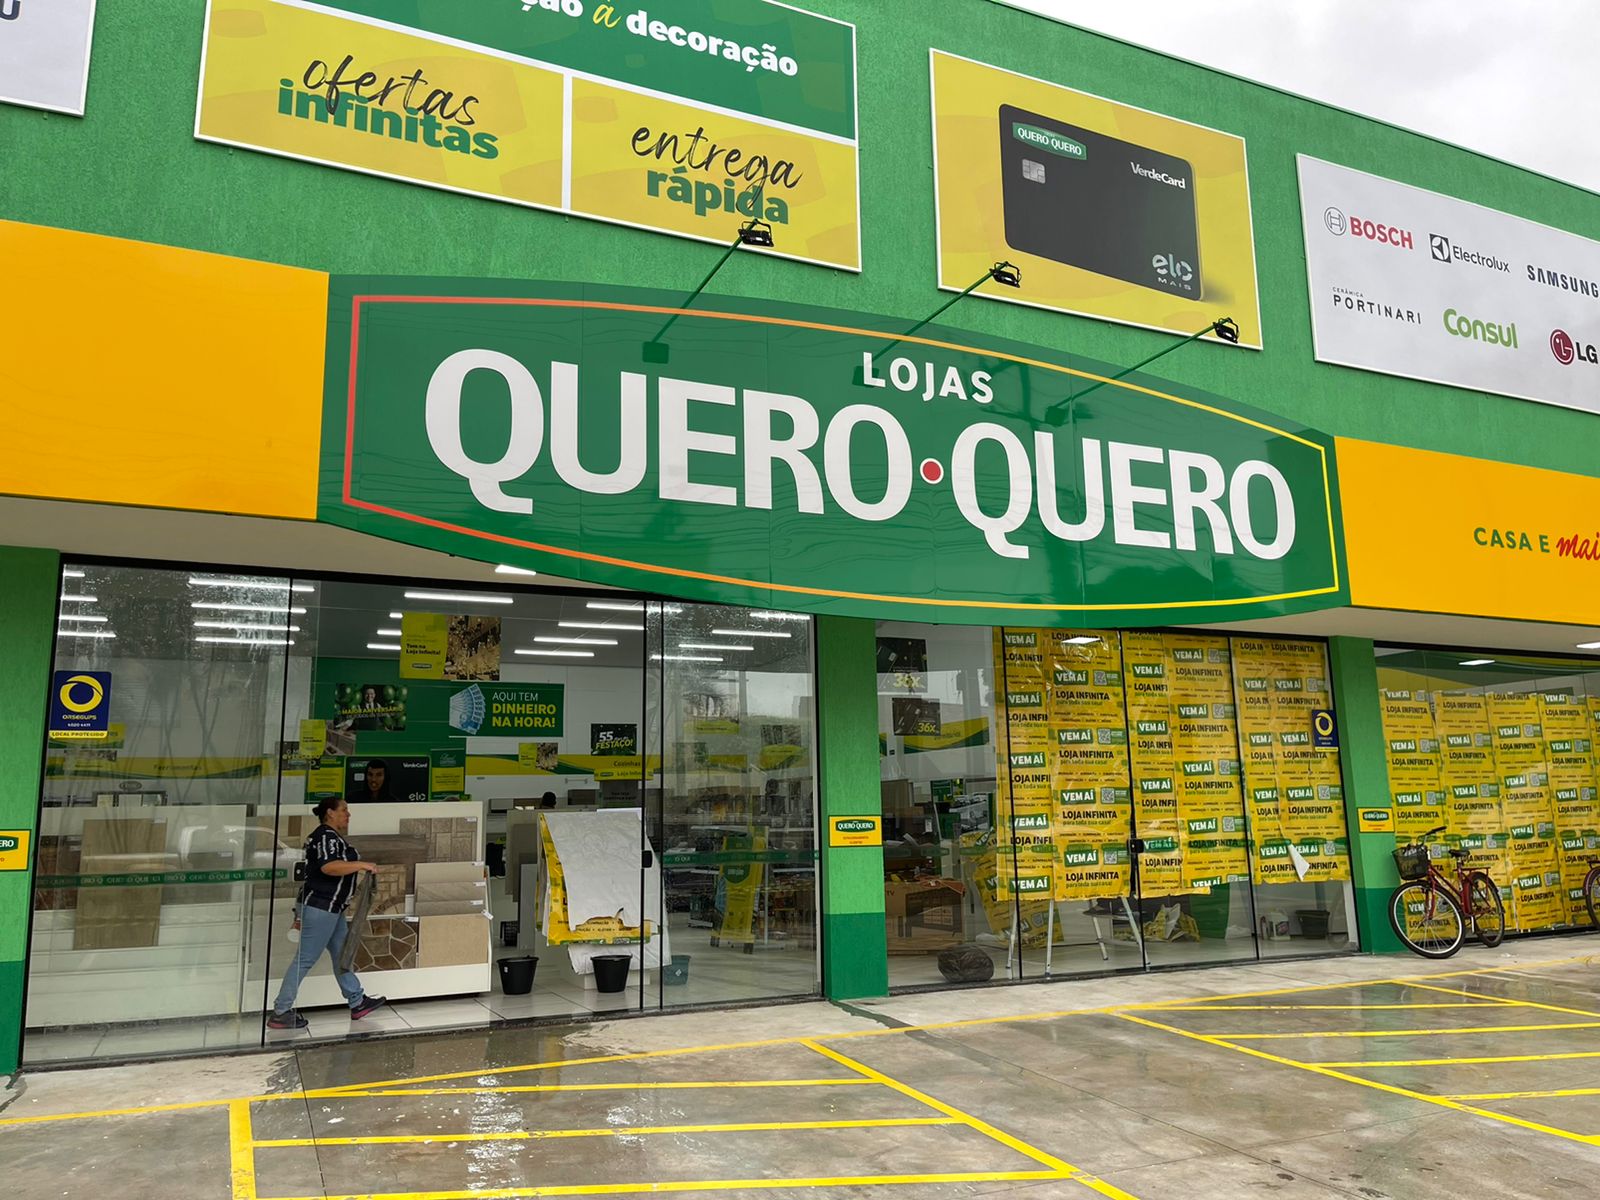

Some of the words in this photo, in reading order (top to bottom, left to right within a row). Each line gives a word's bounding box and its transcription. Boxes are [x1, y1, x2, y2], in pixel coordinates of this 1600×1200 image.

[626, 10, 798, 76] decoração
[303, 55, 479, 126] ofertas
[278, 78, 499, 160] infinitas
[1017, 127, 1049, 145] QUERO
[1051, 140, 1082, 156] QUERO
[631, 127, 803, 212] entrega
[1130, 161, 1186, 189] VerdeCard
[647, 167, 789, 225] rápida
[1350, 216, 1413, 250] BOSCH
[1453, 246, 1511, 273] Electrolux
[1152, 253, 1193, 281] elo
[1158, 276, 1192, 290] MAIS
[1526, 264, 1599, 298] SAMSUNG
[1332, 287, 1364, 298] CERÂMICA
[1333, 294, 1421, 325] PORTINARI
[1443, 308, 1518, 349] Consul
[1576, 342, 1599, 365] LG
[862, 351, 994, 406] LOJAS
[425, 348, 913, 521] QUERO
[951, 421, 1297, 561] QUERO
[1473, 527, 1533, 551] CASA
[1539, 534, 1550, 553] E
[1005, 635, 1022, 644] VEM
[1175, 651, 1192, 659] VEM
[1194, 650, 1202, 659] AÍ
[1134, 666, 1152, 675] VEM
[1154, 664, 1163, 674] AÍ
[1176, 667, 1191, 676] LOJA
[1193, 668, 1223, 676] INFINITA
[1056, 672, 1075, 681] VEM
[1077, 671, 1086, 681] AÍ
[1134, 683, 1151, 692] LOJA
[492, 691, 516, 702] AQUI
[518, 692, 538, 701] TEM
[1008, 695, 1029, 703] VEM
[1056, 691, 1075, 700] LOJA
[1076, 691, 1110, 700] INFINITA
[492, 703, 556, 714] DINHEIRO
[1180, 707, 1197, 715] VEM
[1199, 704, 1207, 714] AÍ
[1402, 706, 1428, 714] INFINITA
[492, 716, 511, 727] NA
[514, 717, 556, 728] HORA!
[917, 722, 936, 733] 36x
[1138, 723, 1156, 732] VEM
[1157, 721, 1166, 731] AÍ
[1180, 724, 1196, 732] LOJA
[1197, 724, 1229, 732] INFINITA
[599, 731, 614, 742] 55
[1060, 732, 1079, 741] VEM
[1081, 729, 1091, 740] AÍ
[1250, 735, 1267, 743] VEM
[1300, 732, 1308, 742] AÍ
[595, 738, 633, 750] FESTAÇO!
[1138, 740, 1154, 749] LOJA
[1391, 742, 1406, 750] VEM
[1407, 740, 1415, 750] AÍ
[1010, 756, 1032, 765] VEM
[1033, 751, 1043, 764] AÍ
[1059, 750, 1078, 759] LOJA
[1080, 750, 1114, 758] INFINITA
[1251, 752, 1266, 760] LOJA
[1184, 764, 1202, 772] VEM
[1204, 761, 1212, 771] AÍ
[1392, 758, 1406, 766] LOJA
[1407, 758, 1434, 766] INFINITA
[1142, 781, 1160, 790] VEM
[1161, 778, 1171, 789] AÍ
[1185, 781, 1202, 790] LOJA
[1203, 781, 1234, 789] INFINITA
[1063, 792, 1082, 801] VEM
[1084, 790, 1094, 800] AÍ
[1255, 791, 1272, 799] VEM
[1288, 789, 1304, 798] VEM
[1454, 787, 1469, 795] VEM
[1469, 785, 1477, 794] AÍ
[408, 792, 426, 801] elo
[1397, 795, 1412, 803] VEM
[1413, 793, 1421, 802] AÍ
[1142, 800, 1158, 808] LOJA
[1454, 803, 1468, 811] LOJA
[1063, 811, 1082, 820] LOJA
[1083, 811, 1117, 819] INFINITA
[1256, 808, 1273, 816] LOJA
[1288, 806, 1305, 815] LOJA
[1305, 806, 1333, 814] INFINITA
[1397, 811, 1411, 819] LOJA
[838, 822, 855, 830] QUERO
[856, 822, 873, 830] QUERO
[1189, 822, 1207, 831] VEM
[1207, 819, 1216, 829] AÍ
[1260, 847, 1277, 856] VEM
[1278, 845, 1287, 855] AÍ
[1066, 853, 1085, 863] VEM
[1087, 850, 1096, 861] AÍ
[1145, 859, 1160, 868] LOJA
[1260, 864, 1276, 873] LOJA
[1066, 873, 1084, 882] LOJA
[1085, 872, 1119, 880] INFINITA
